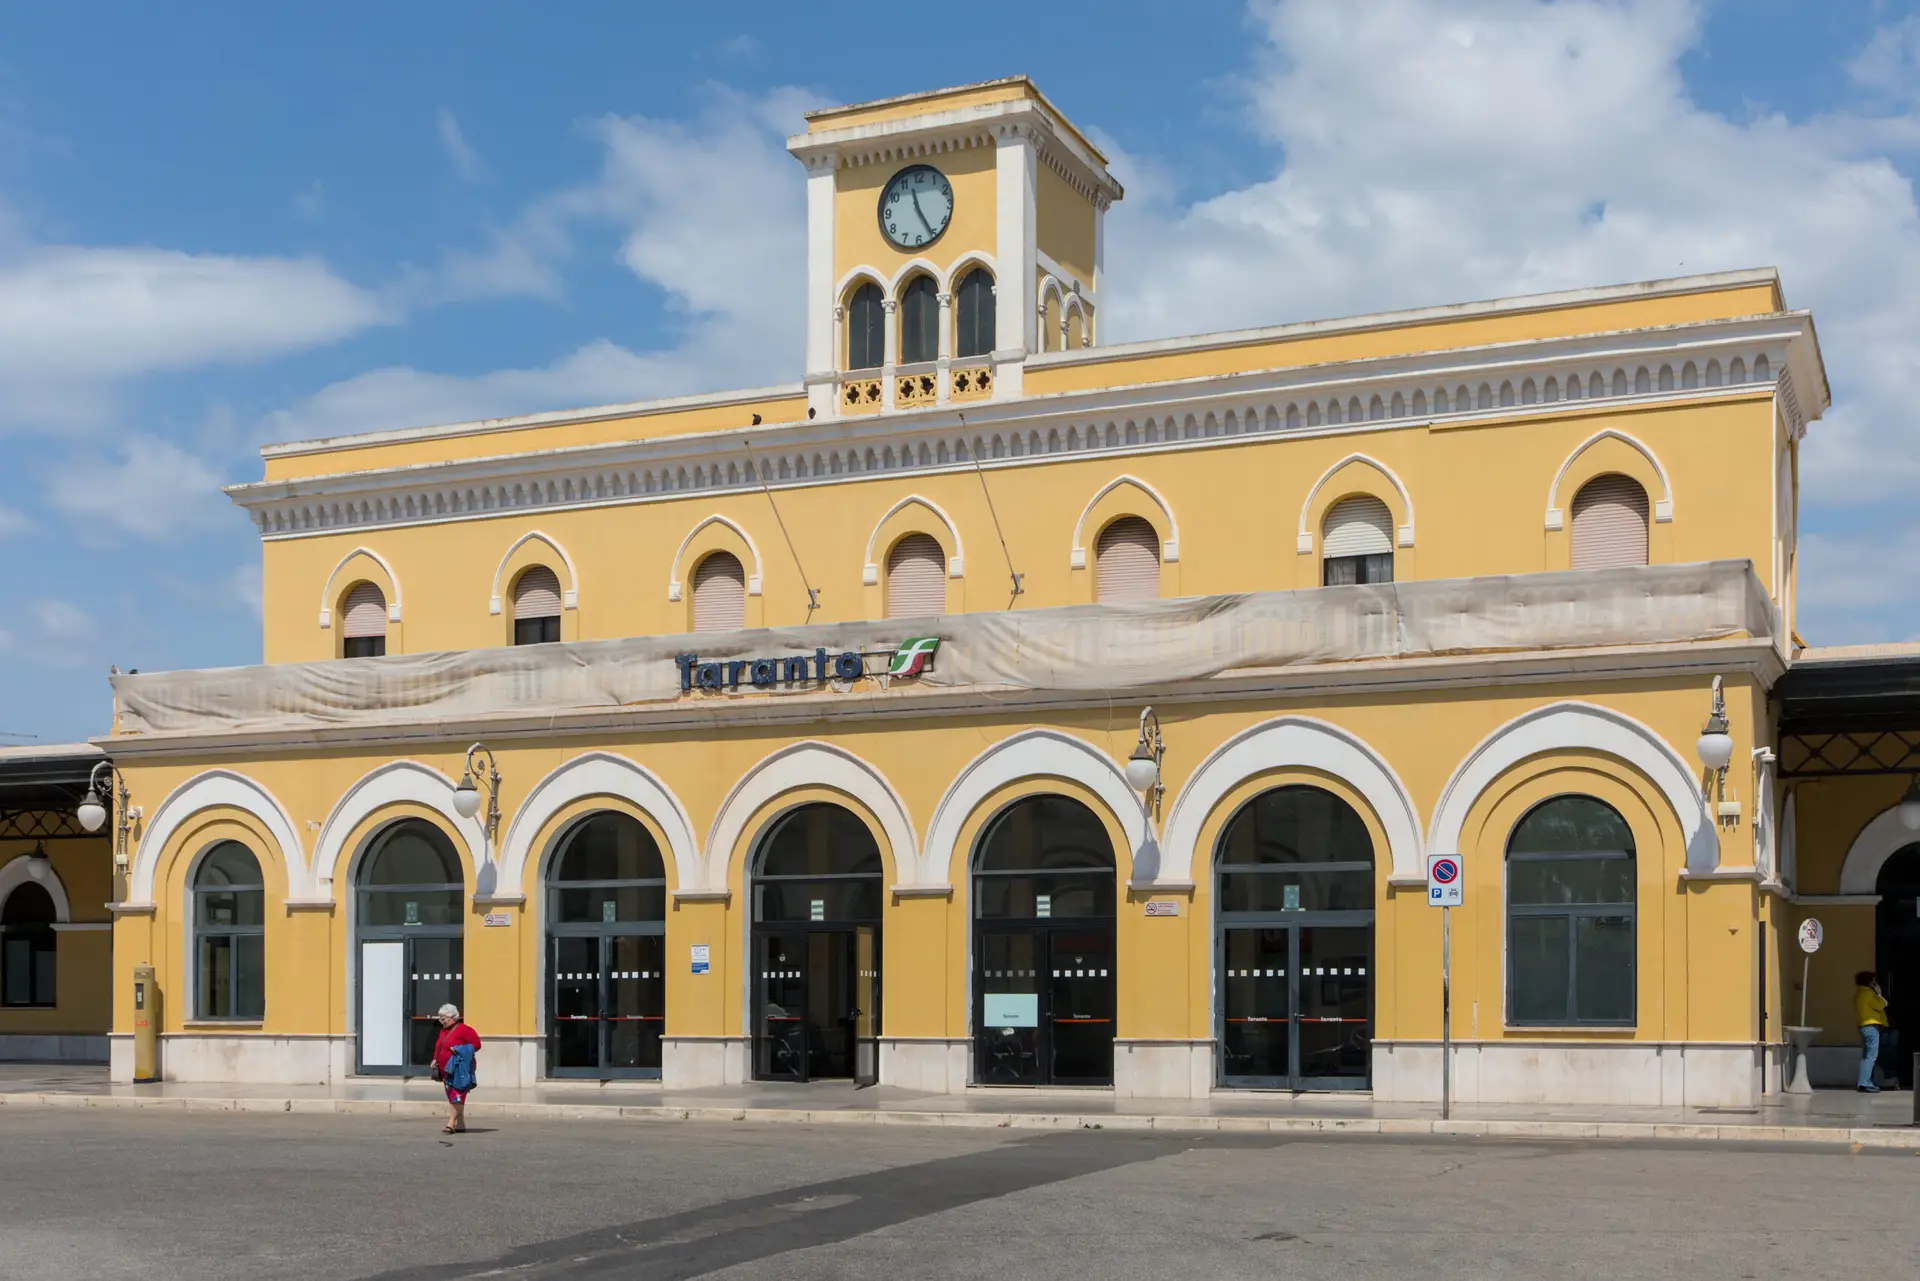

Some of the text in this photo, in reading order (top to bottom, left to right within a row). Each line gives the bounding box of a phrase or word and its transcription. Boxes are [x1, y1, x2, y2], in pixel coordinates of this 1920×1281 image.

[914, 172, 924, 184] 12
[901, 178, 908, 190] 11
[942, 184, 949, 195] 2
[890, 192, 900, 203] 10
[946, 199, 952, 210] 3
[885, 208, 892, 219] 9
[940, 215, 947, 225] 4
[890, 223, 896, 234] 8
[931, 228, 937, 237] 5
[902, 232, 909, 244] 7
[915, 235, 922, 245] 6
[674, 647, 863, 690] Taranto
